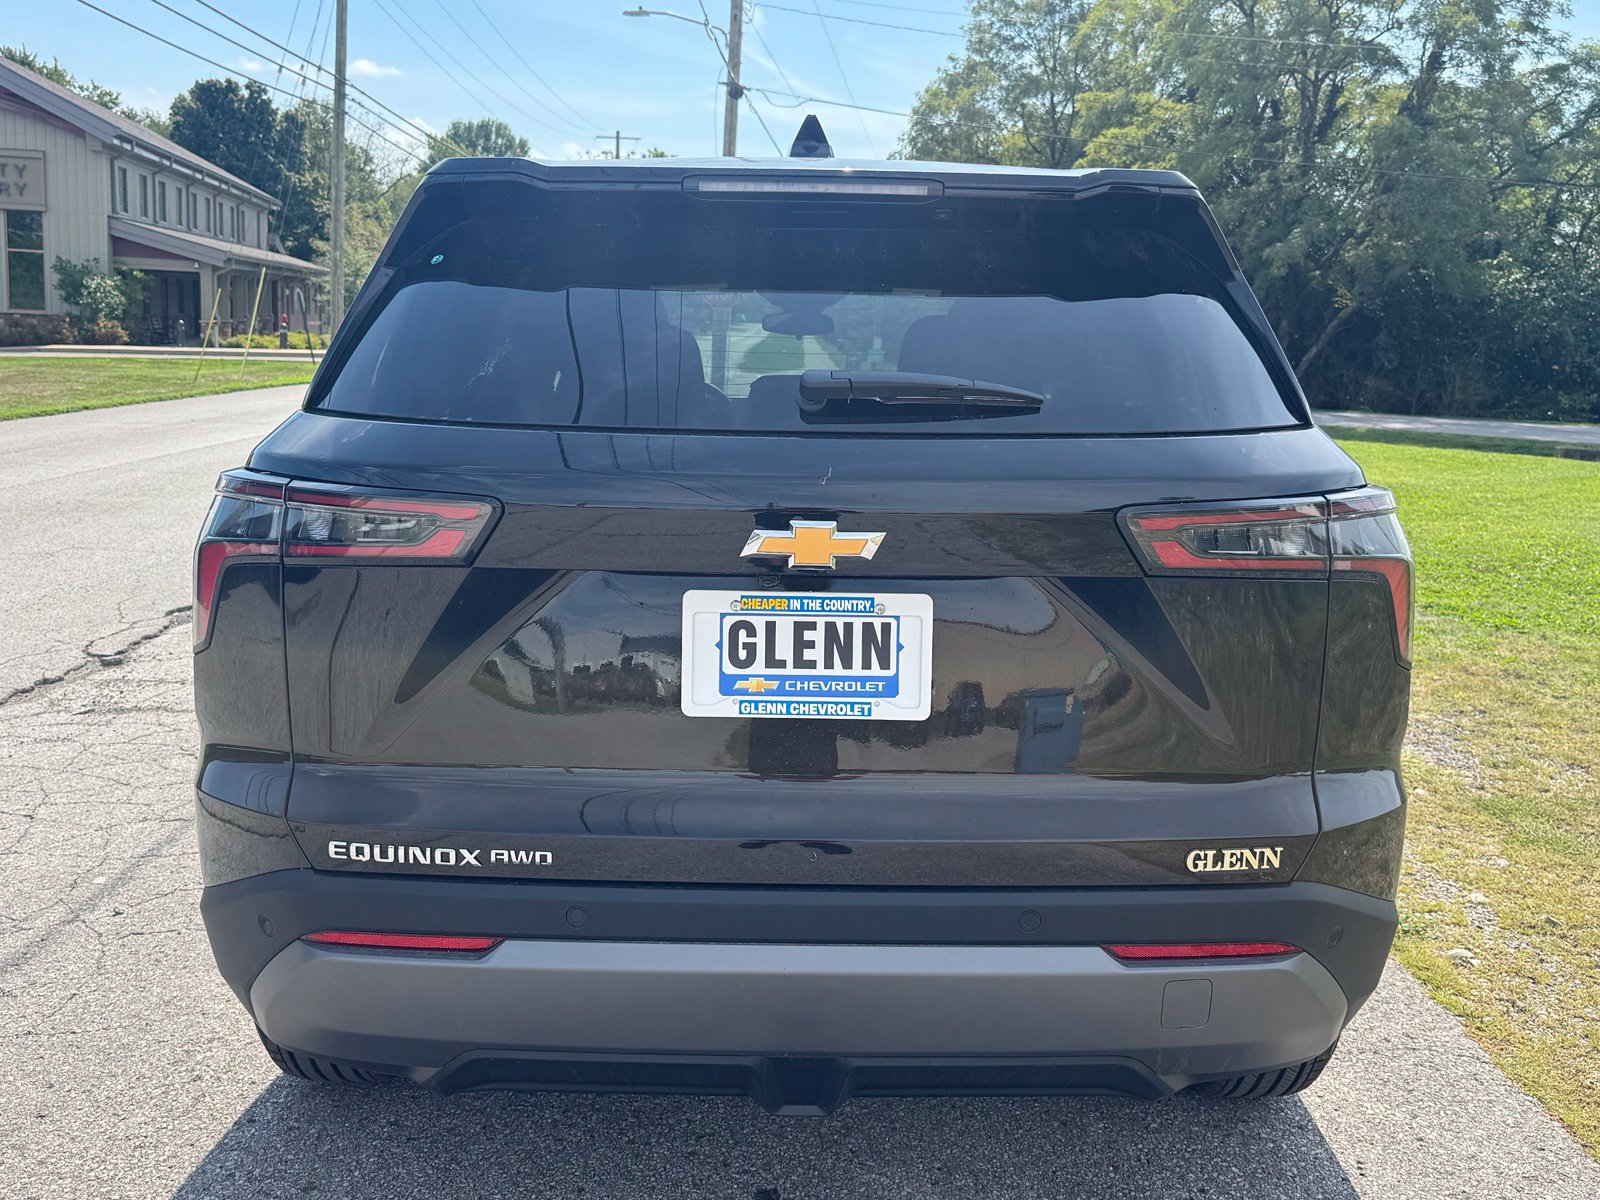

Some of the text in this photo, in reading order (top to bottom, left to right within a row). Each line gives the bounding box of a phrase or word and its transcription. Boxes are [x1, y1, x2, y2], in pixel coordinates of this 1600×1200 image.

[741, 598, 874, 612] CHEAPER IN THE COUNTRY.
[728, 619, 892, 671] GLENN
[785, 680, 886, 692] CHEVROLET
[740, 703, 871, 716] GLENN CHEVROLET
[328, 840, 553, 867] EQUINOX AWD
[1185, 847, 1284, 873] GLENN
